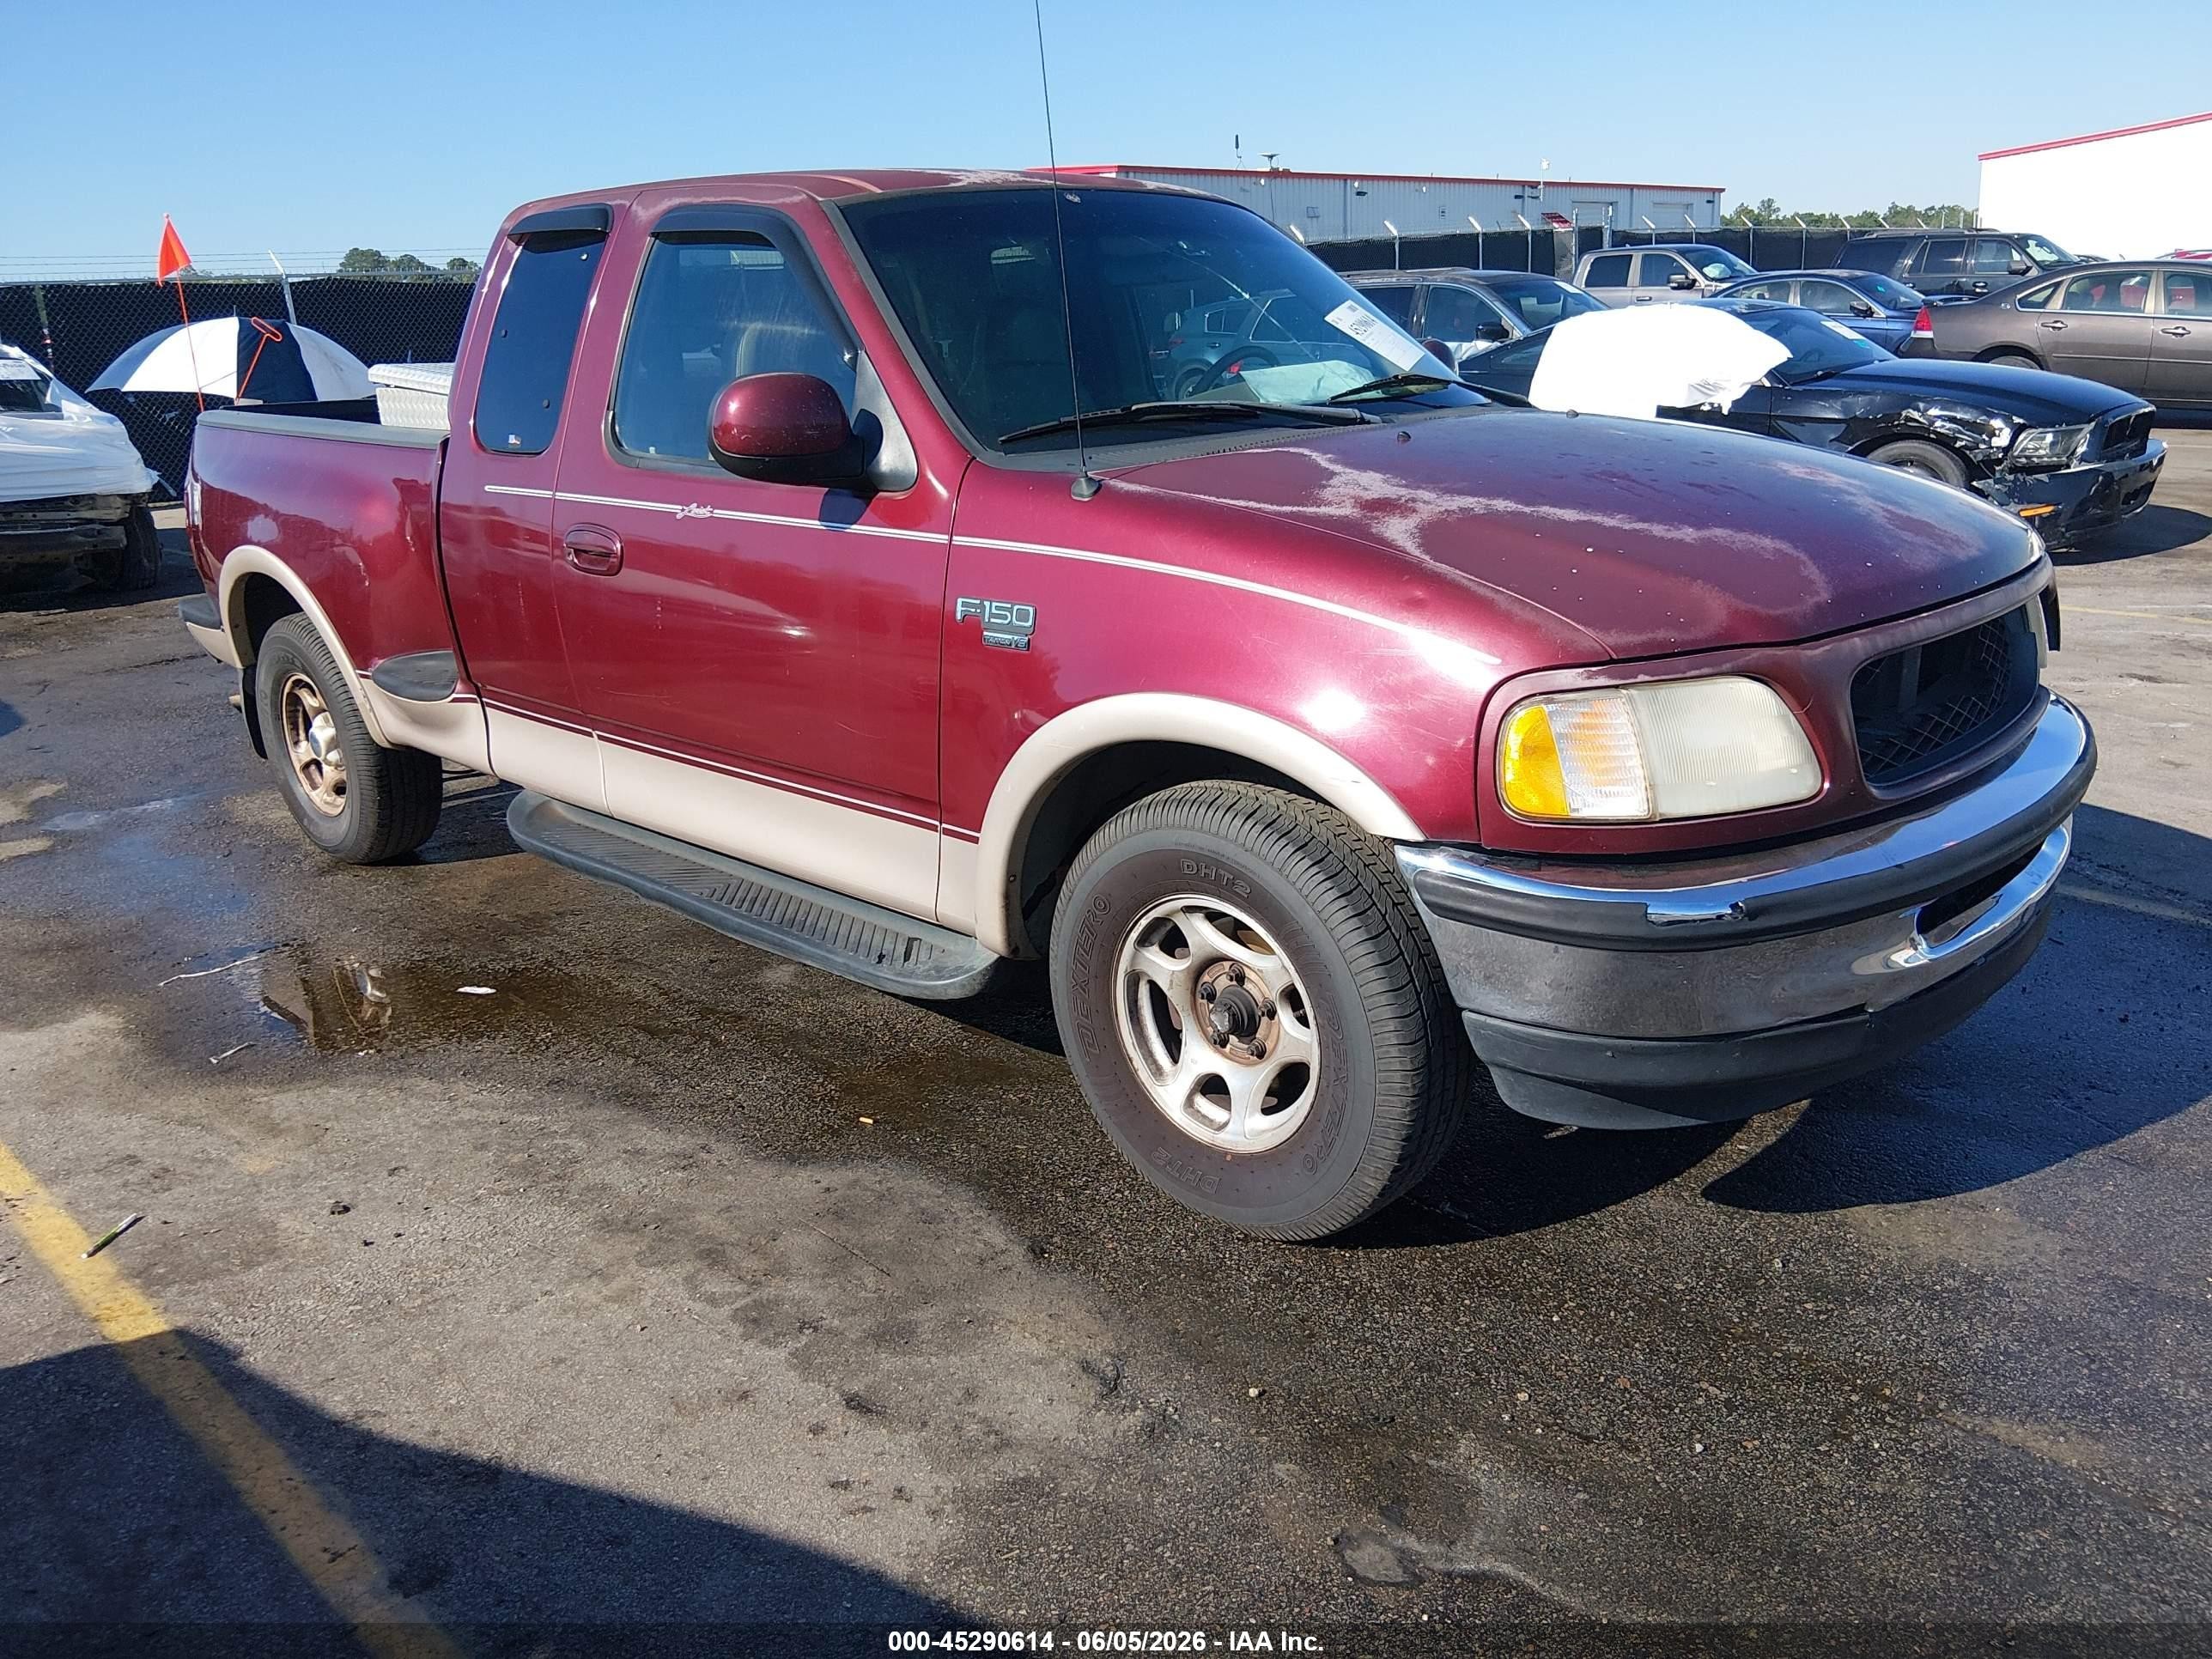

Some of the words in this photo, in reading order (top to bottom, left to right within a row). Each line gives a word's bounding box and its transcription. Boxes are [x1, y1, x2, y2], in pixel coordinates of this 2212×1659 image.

[956, 598, 1035, 627] F-150
[1181, 859, 1252, 898] DHT2
[1072, 894, 1110, 1061] DEXTERO
[1152, 1146, 1221, 1194] DHT2
